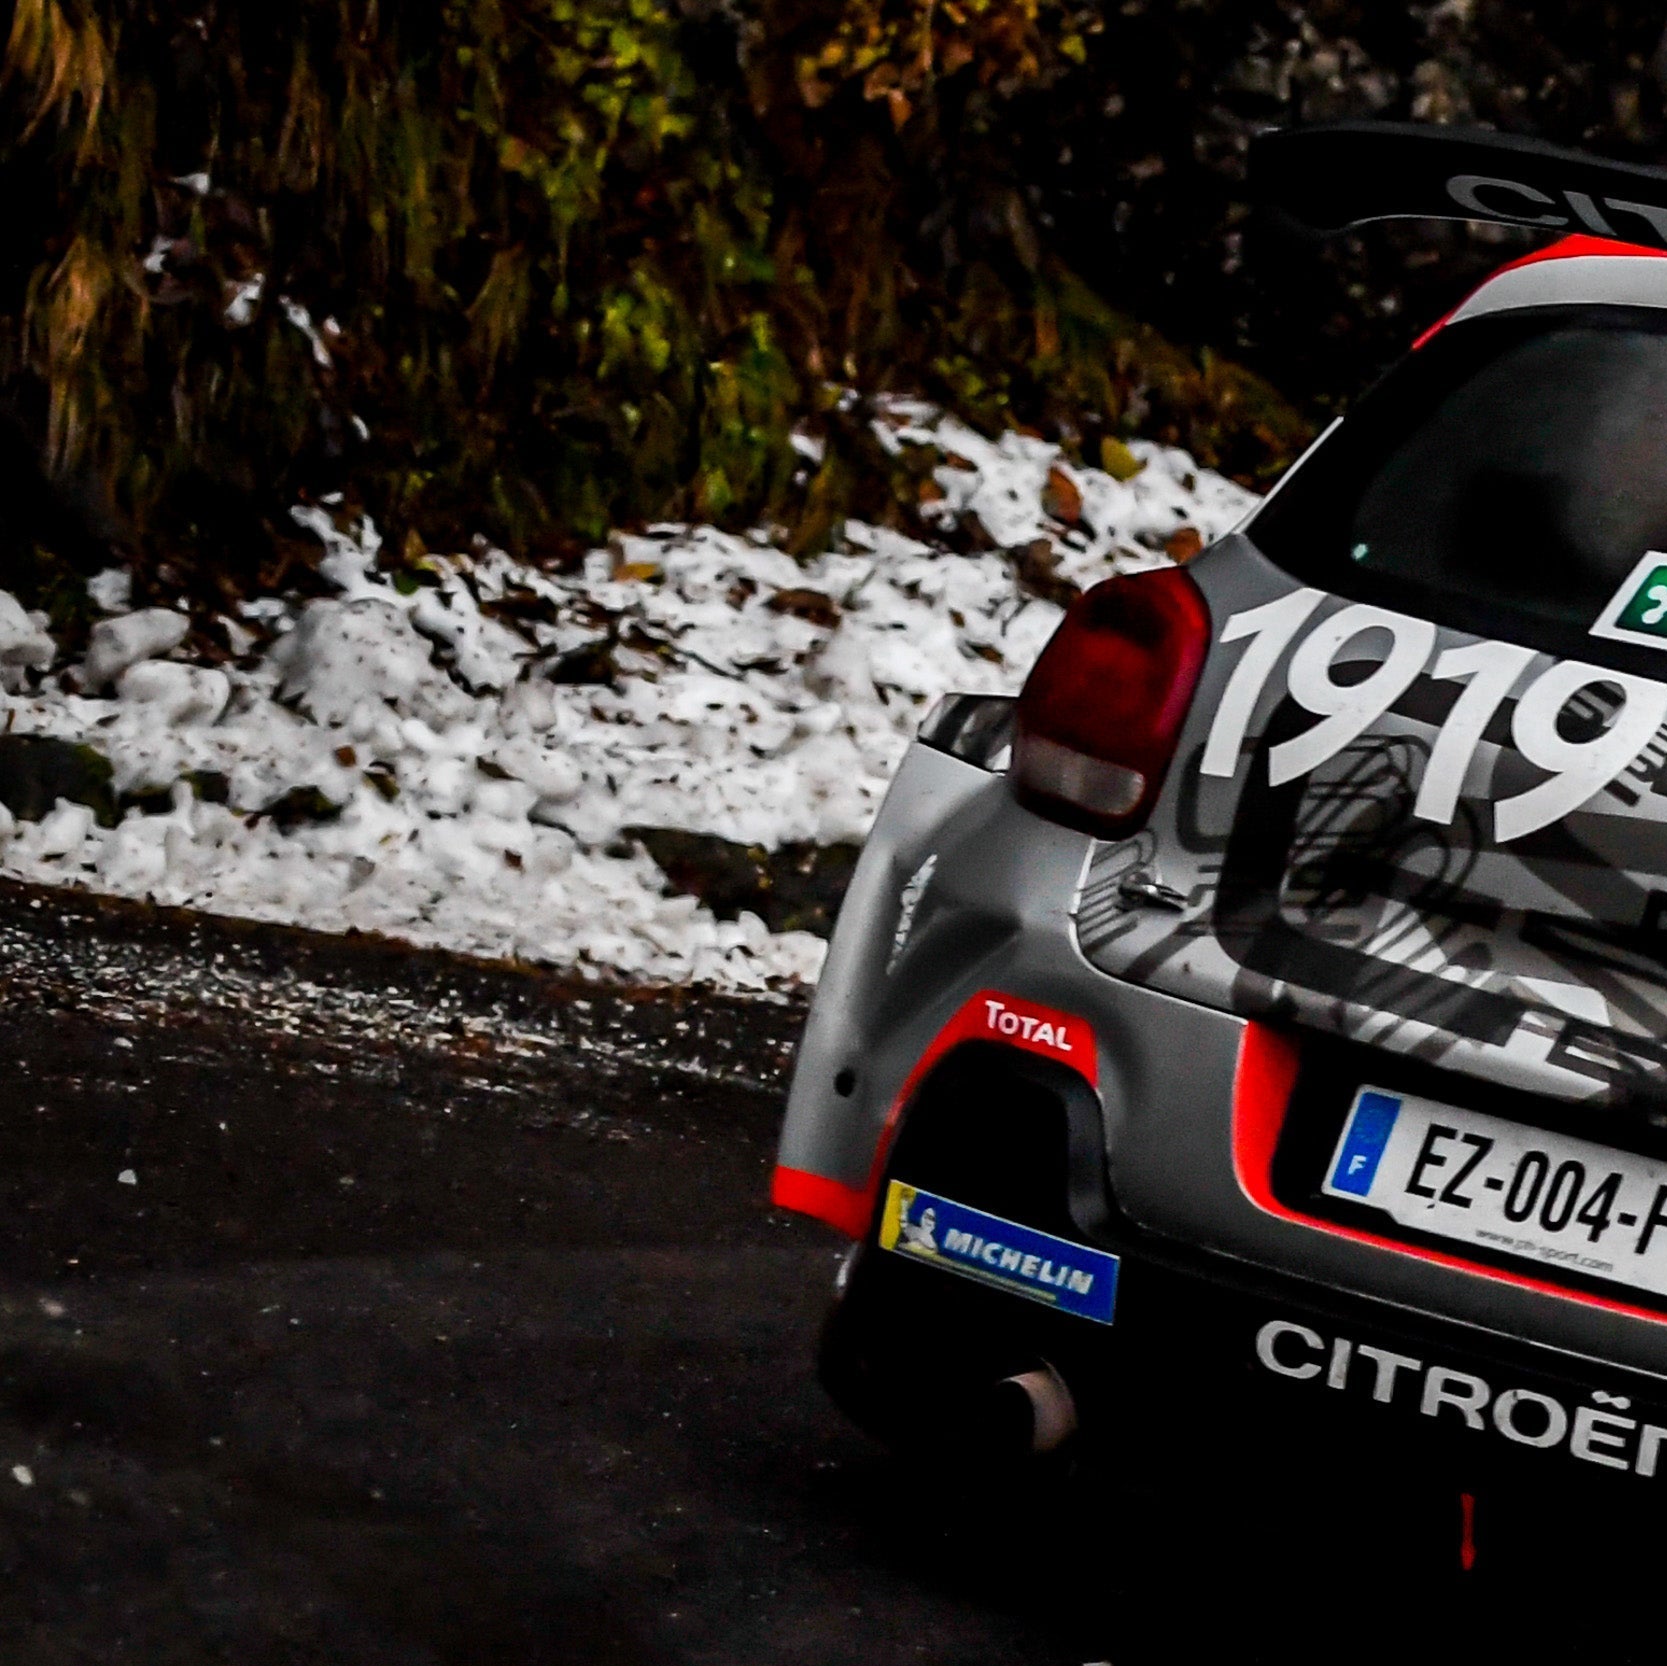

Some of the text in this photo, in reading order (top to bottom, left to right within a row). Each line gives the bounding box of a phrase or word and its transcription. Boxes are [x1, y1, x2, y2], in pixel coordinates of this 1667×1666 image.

[985, 999, 1072, 1051] TOTAL
[1347, 1154, 1367, 1175] F
[944, 1228, 1095, 1295] MICHELIN
